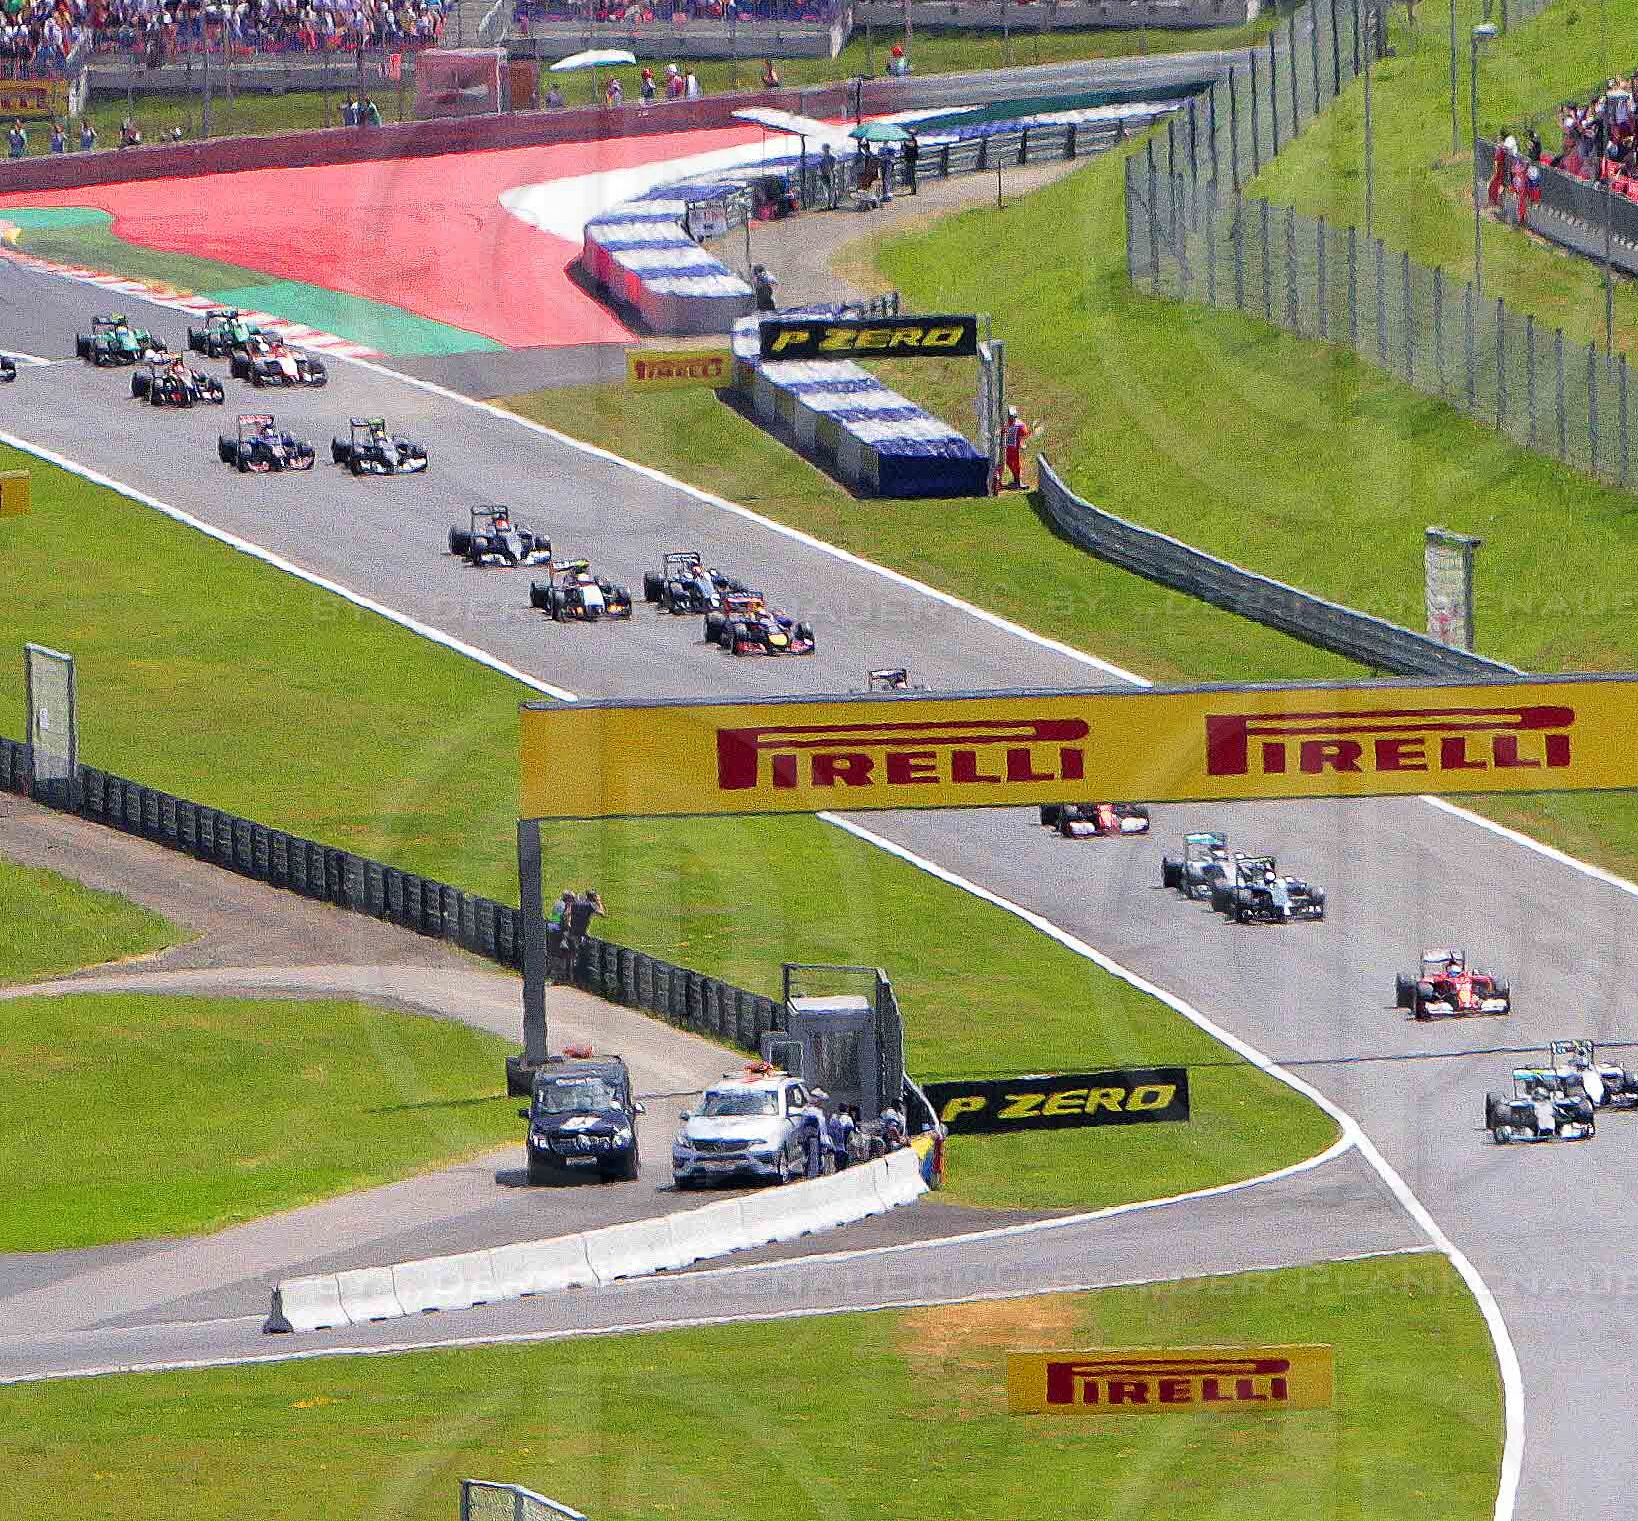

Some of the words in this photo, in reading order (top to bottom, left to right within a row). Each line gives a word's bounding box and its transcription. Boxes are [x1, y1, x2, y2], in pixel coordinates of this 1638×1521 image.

[771, 329, 809, 351] P
[818, 326, 966, 350] ZERO
[716, 718, 1089, 791] PIRELLI
[1205, 706, 1576, 776] PIRELLI
[941, 1095, 987, 1123] P
[997, 1083, 1178, 1120] ZERO
[1046, 1358, 1290, 1404] PIRELLI
